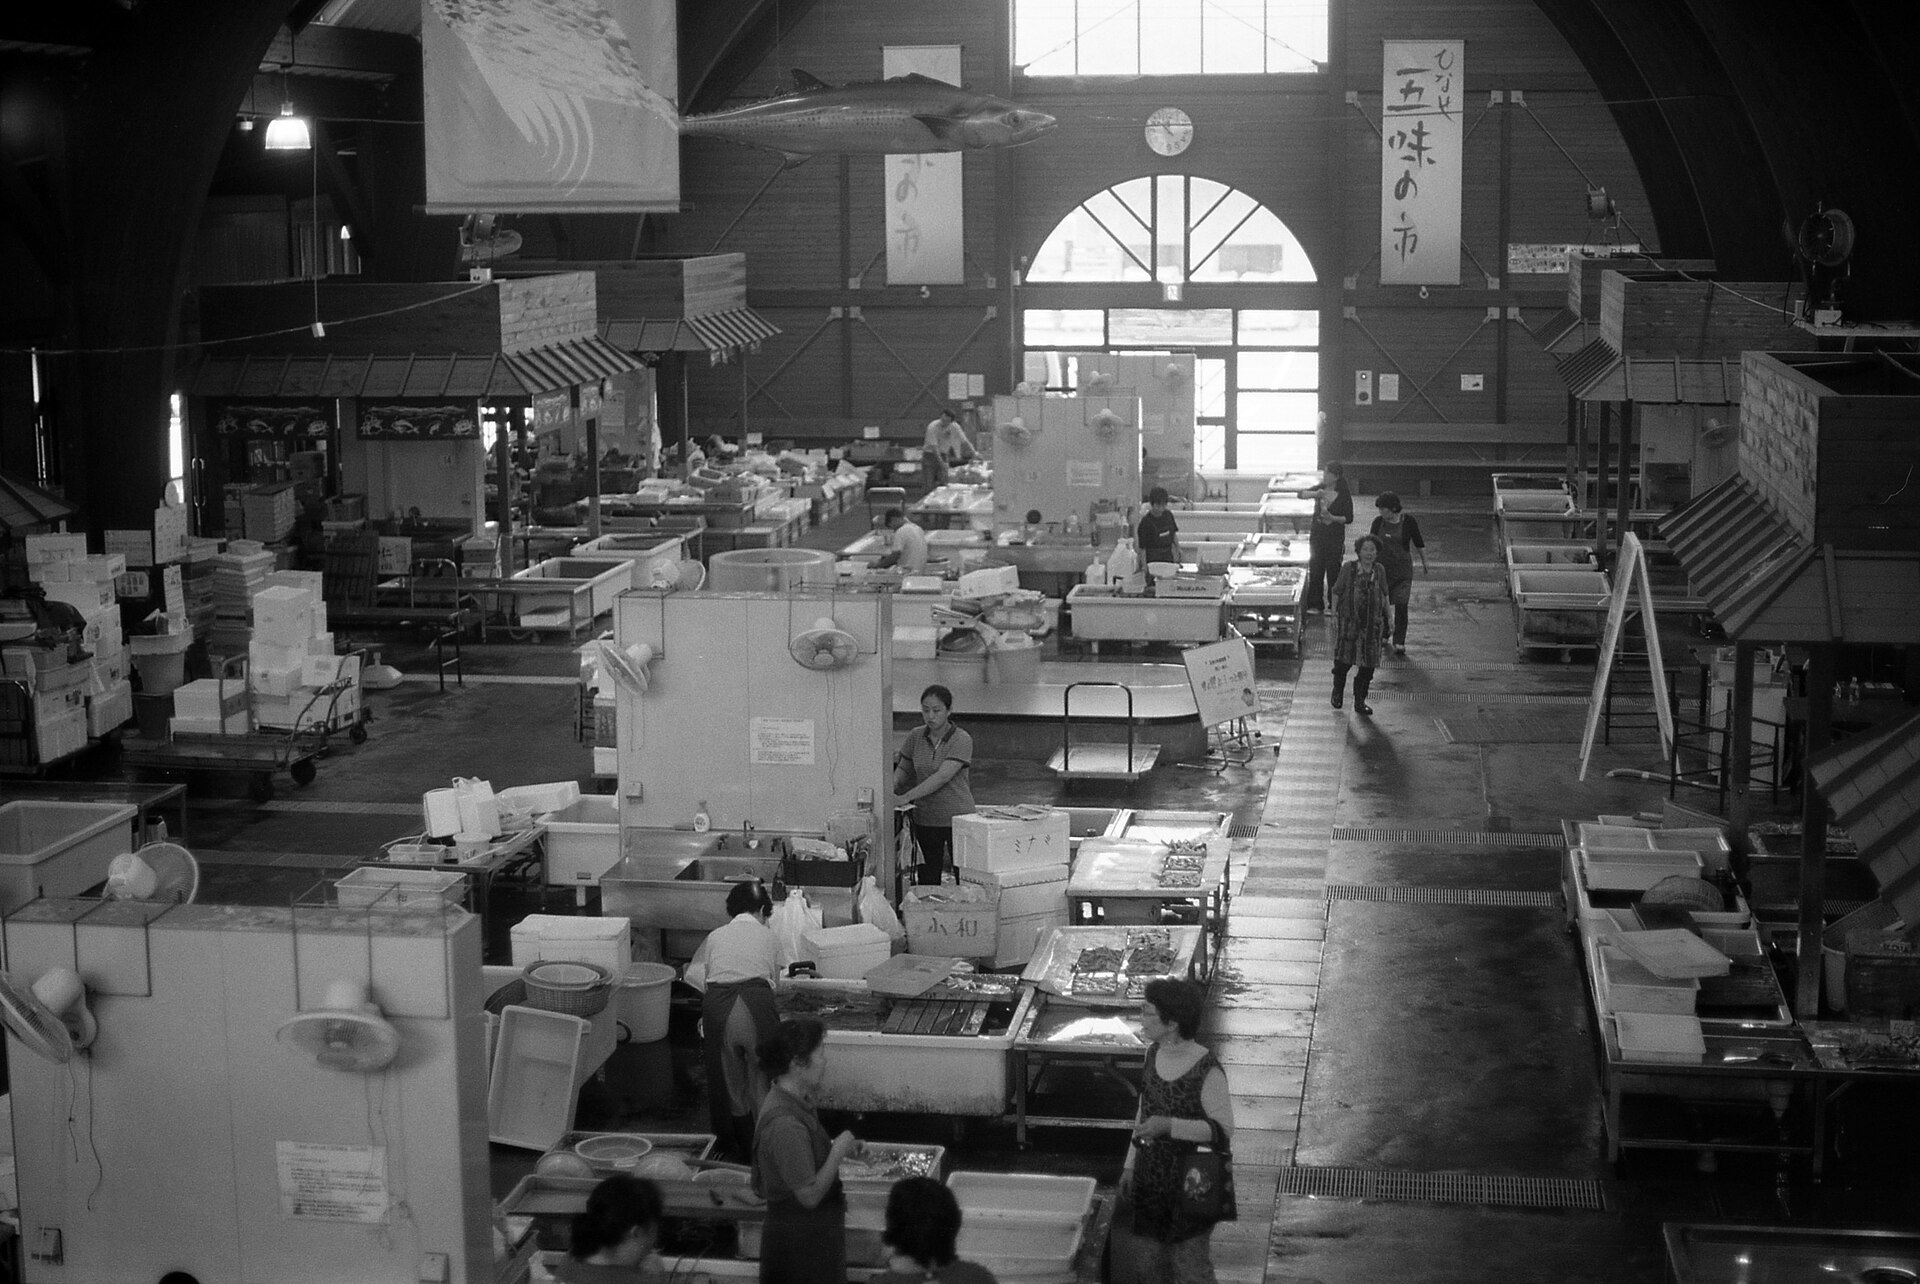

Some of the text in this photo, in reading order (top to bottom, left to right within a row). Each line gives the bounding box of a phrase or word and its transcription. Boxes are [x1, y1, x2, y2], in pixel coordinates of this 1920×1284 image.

[1434, 48, 1455, 123] ひなせ
[1386, 67, 1437, 264] 五味の市
